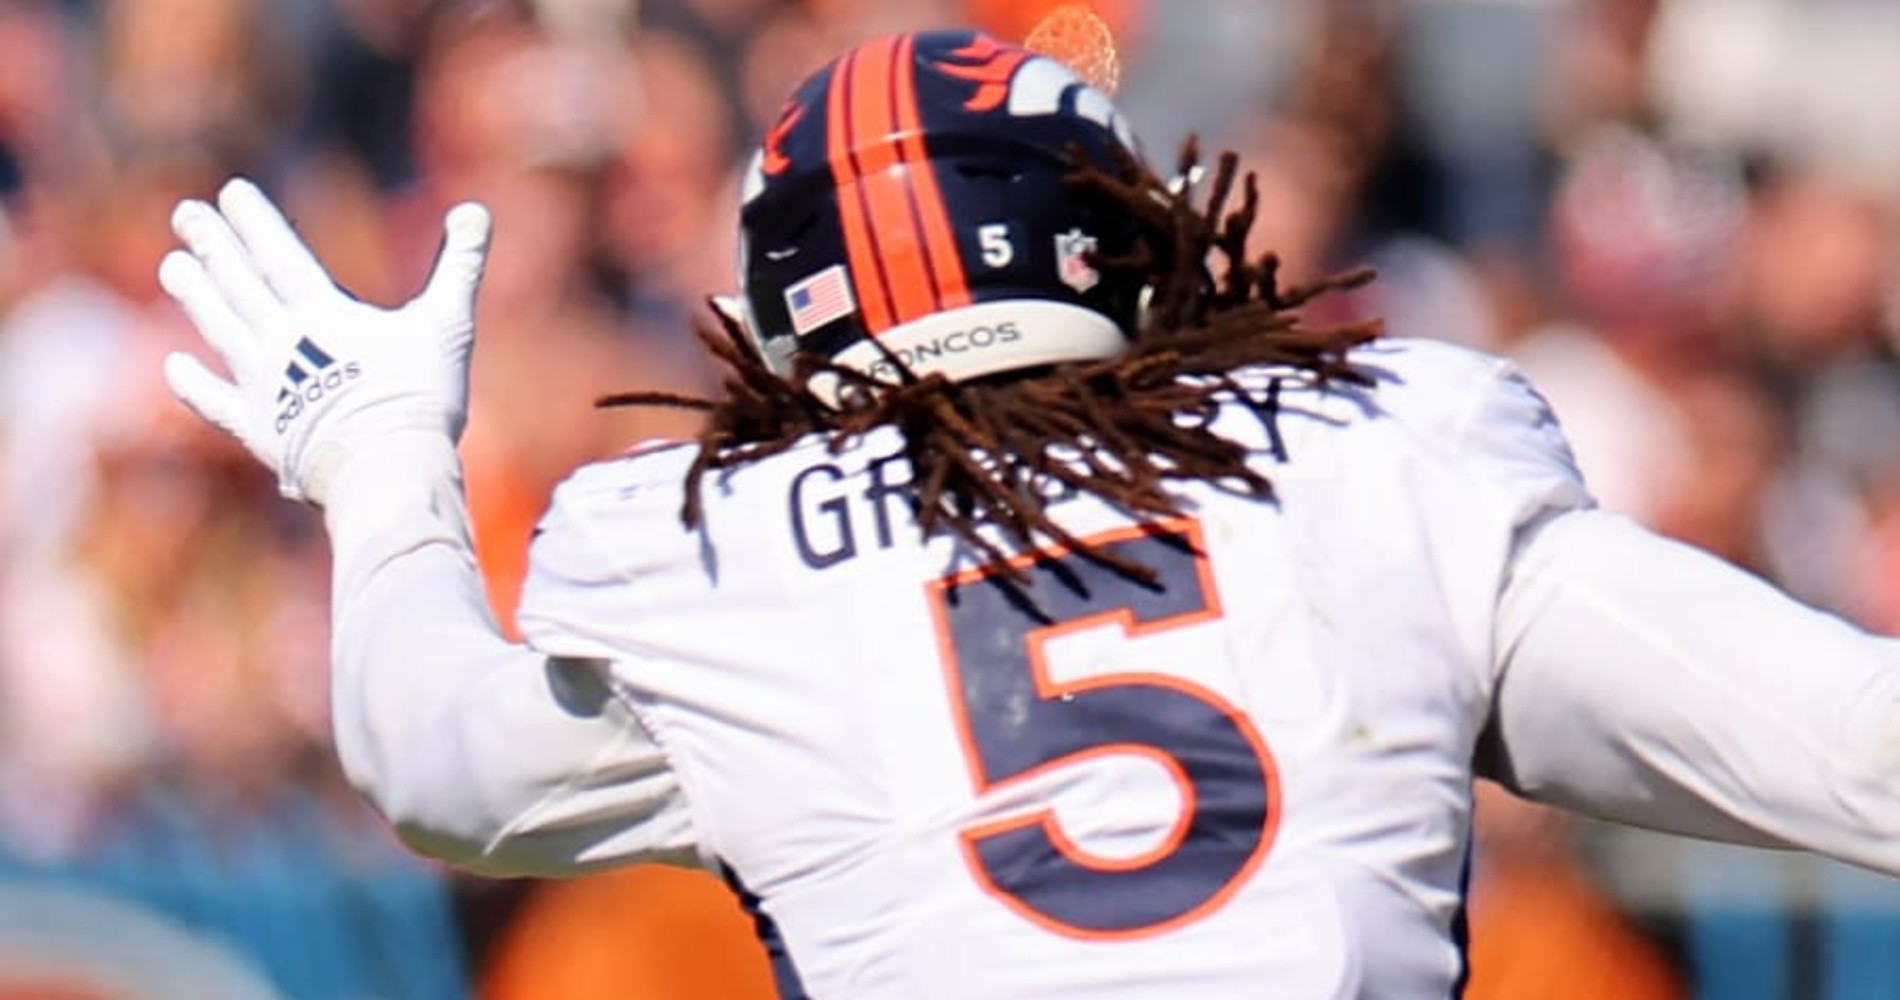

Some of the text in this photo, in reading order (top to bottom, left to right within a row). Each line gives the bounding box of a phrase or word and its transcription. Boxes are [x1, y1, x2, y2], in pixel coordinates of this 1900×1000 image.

[979, 224, 1013, 267] 5
[275, 360, 361, 435] adidas
[924, 518, 1282, 942] 5
